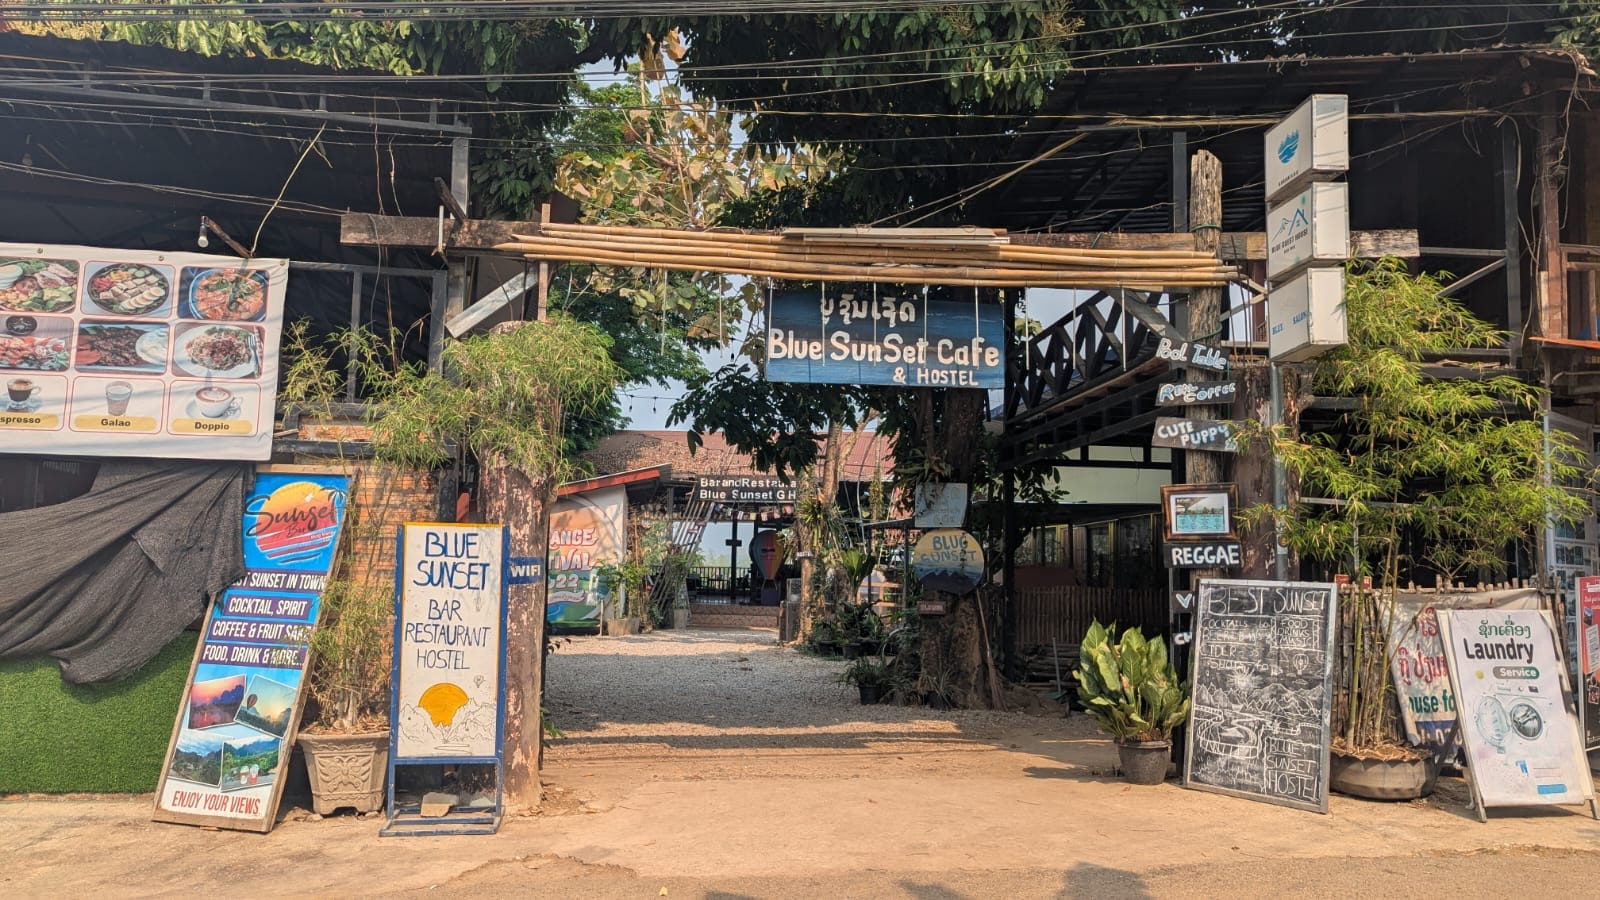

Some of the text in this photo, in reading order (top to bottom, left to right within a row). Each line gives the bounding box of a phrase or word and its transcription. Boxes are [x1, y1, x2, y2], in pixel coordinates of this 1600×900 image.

[768, 328, 1000, 367] Blue SunSet Cafe
[1192, 344, 1227, 370] Table
[892, 367, 979, 386] & HOSTEL
[101, 418, 131, 427] Galao
[194, 421, 230, 432] Doppio
[1157, 421, 1195, 439] CUTE
[700, 489, 726, 499] Blue
[732, 489, 773, 500] Sunset
[245, 494, 336, 537] Sunset
[425, 531, 479, 559] BLUE
[1172, 545, 1239, 566] REGGAE
[250, 572, 288, 589] SUNSET
[286, 574, 298, 590] IN
[300, 574, 327, 590] TOWN
[413, 560, 490, 590] SUNSET
[511, 565, 541, 577] WIFI
[228, 597, 307, 617] COCKTAIL, SPIRIT
[427, 599, 463, 622] BAR
[1207, 587, 1330, 615] BEST SUNSET
[212, 621, 249, 637] COFFEE
[249, 623, 258, 638] &
[257, 624, 286, 640] FRUIT
[404, 622, 492, 648] RESTAURANT
[203, 645, 229, 663] FOOD,
[231, 647, 262, 664] DRINK
[262, 648, 271, 664] &
[416, 649, 471, 670] HOSTEL
[1463, 637, 1534, 665] Laundry
[1500, 667, 1537, 678] Service
[1266, 755, 1317, 774] SUNSET
[172, 790, 261, 815] ENJOY YOUR VIEWS
